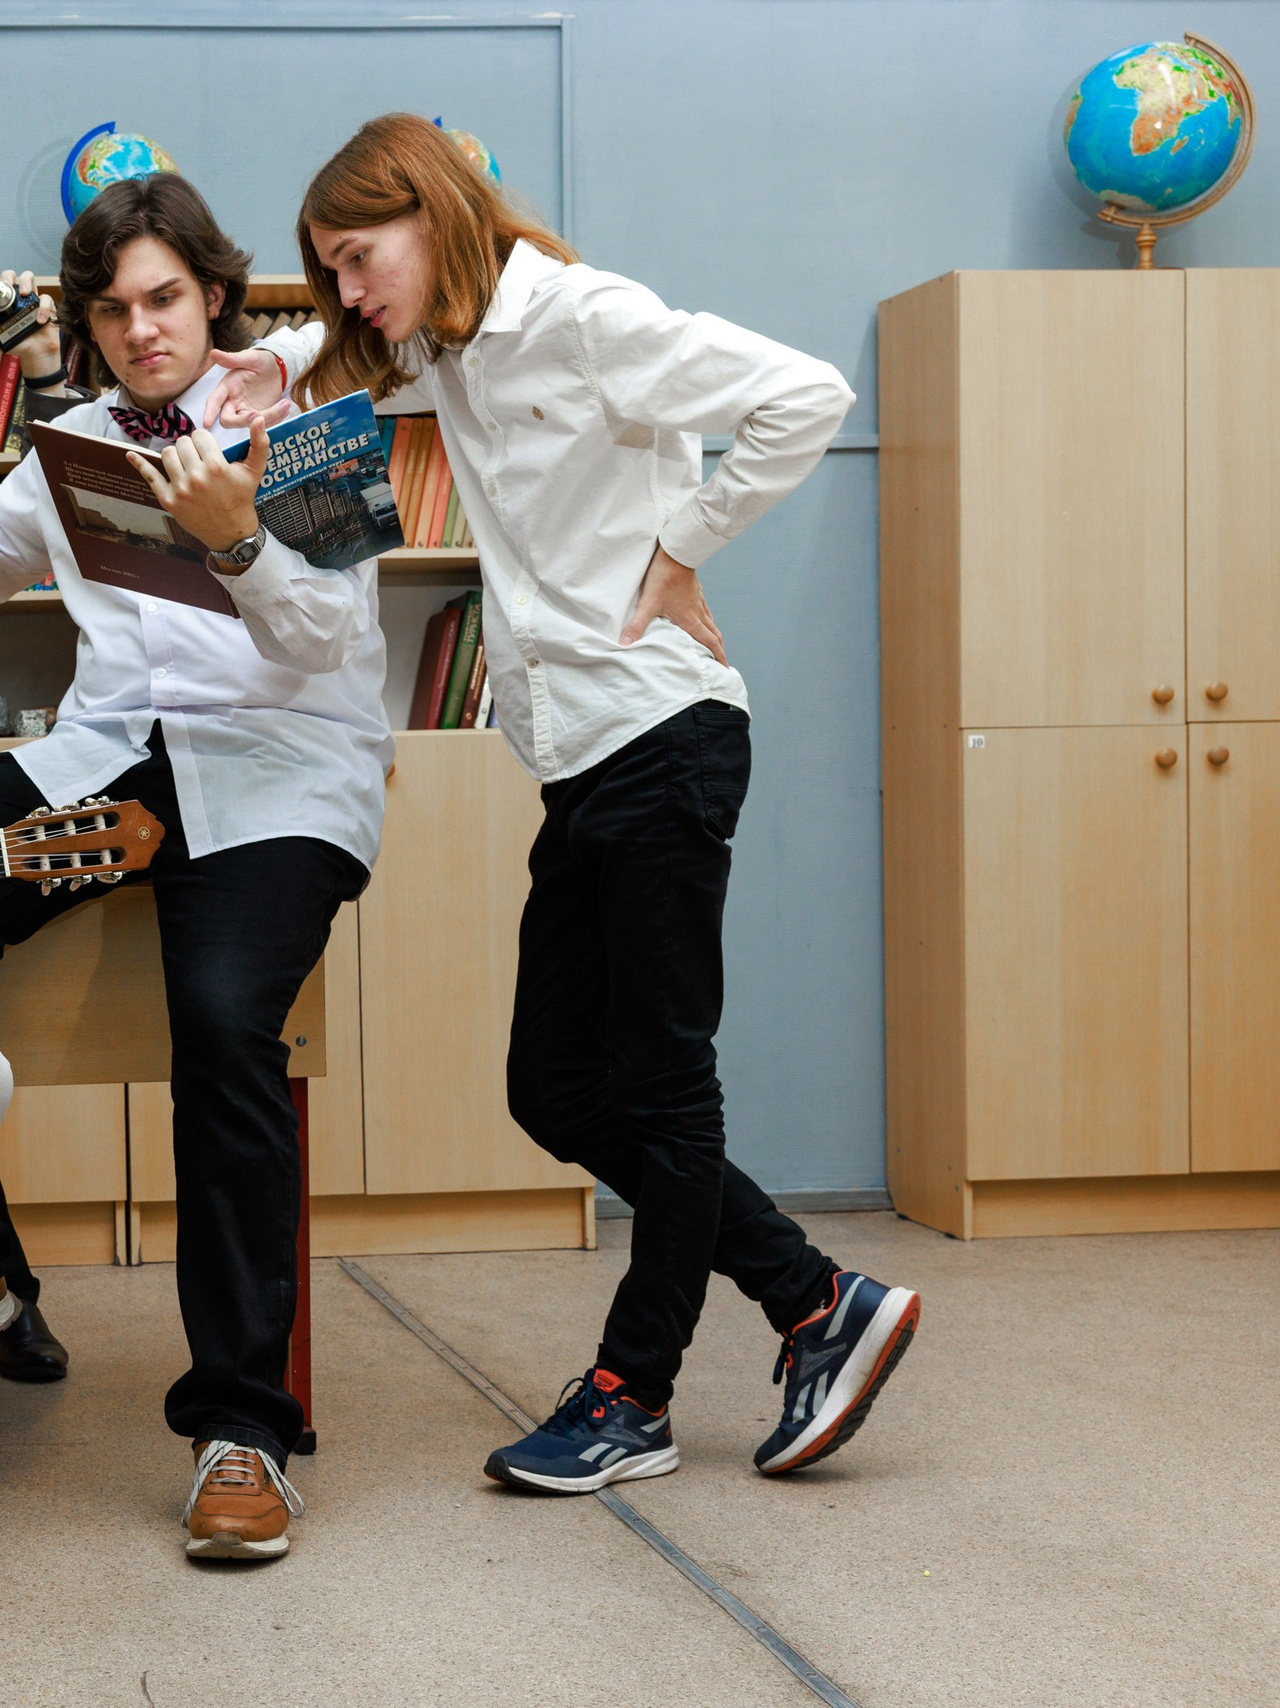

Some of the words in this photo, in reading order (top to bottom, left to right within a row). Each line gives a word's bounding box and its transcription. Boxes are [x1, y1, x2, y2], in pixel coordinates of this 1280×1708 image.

[267, 421, 332, 460] ОВСКОЕ
[267, 436, 327, 473] ЕМЕНИ
[260, 433, 370, 488] ОСТРАНСТВЕ
